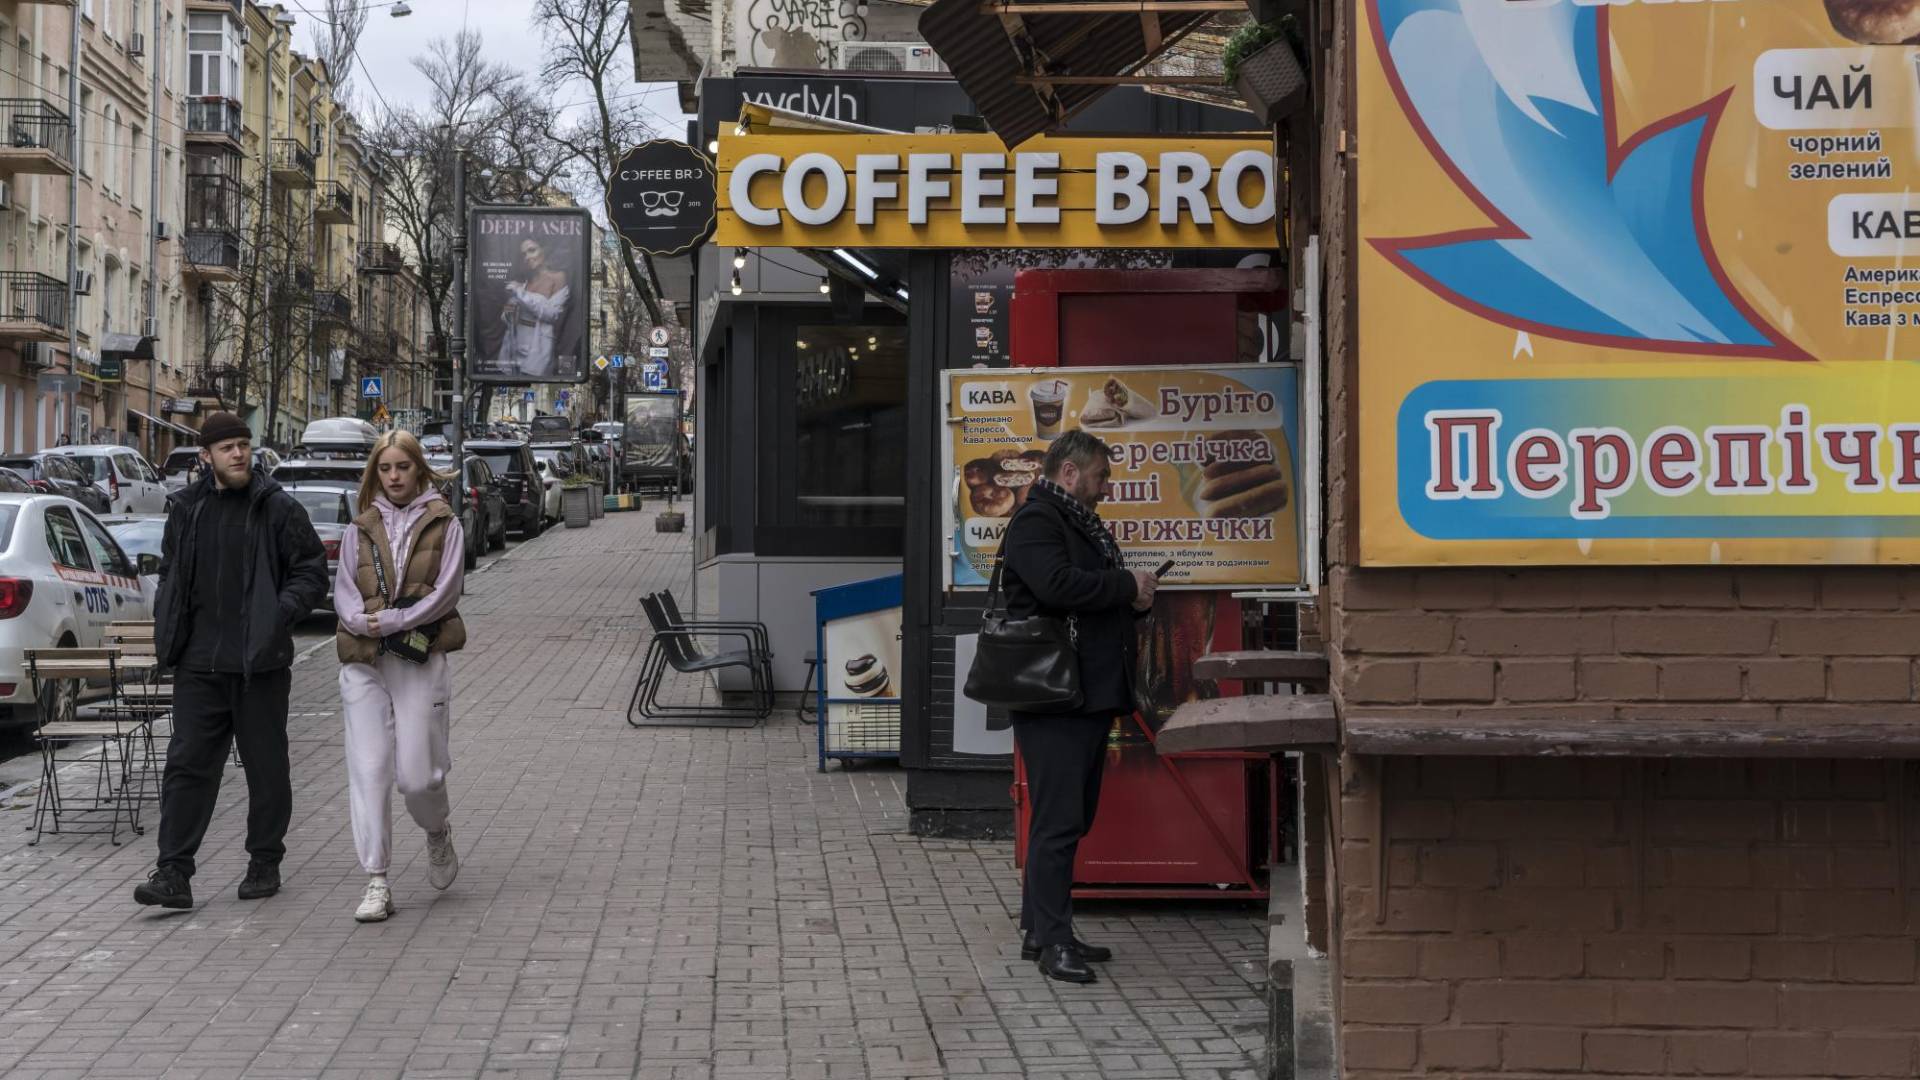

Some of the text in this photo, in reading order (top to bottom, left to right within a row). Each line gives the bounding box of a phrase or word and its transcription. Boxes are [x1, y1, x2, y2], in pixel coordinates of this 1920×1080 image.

[1773, 64, 1872, 110] ЧАЙ
[1789, 131, 1881, 157] чорний
[621, 168, 703, 181] COFFEE BRO
[1790, 158, 1891, 179] зелений
[729, 150, 1276, 227] COFFEE BRO
[481, 219, 582, 236] DEEP LASER
[1844, 267, 1920, 284] Америк
[1846, 311, 1891, 326] Кава
[1897, 314, 1907, 326] з
[968, 390, 1017, 405] КАВА
[1159, 386, 1275, 423] Буріто
[963, 425, 1006, 434] Еспрессо
[963, 436, 984, 444] Кава
[993, 436, 1033, 444] молоком
[1101, 434, 1272, 470] ерепічка
[971, 523, 1006, 540] ЧАЙ
[1176, 549, 1213, 558] яблуком
[1175, 560, 1203, 568] сиром
[1216, 559, 1270, 568] родзинками
[84, 586, 110, 614] OTIS
